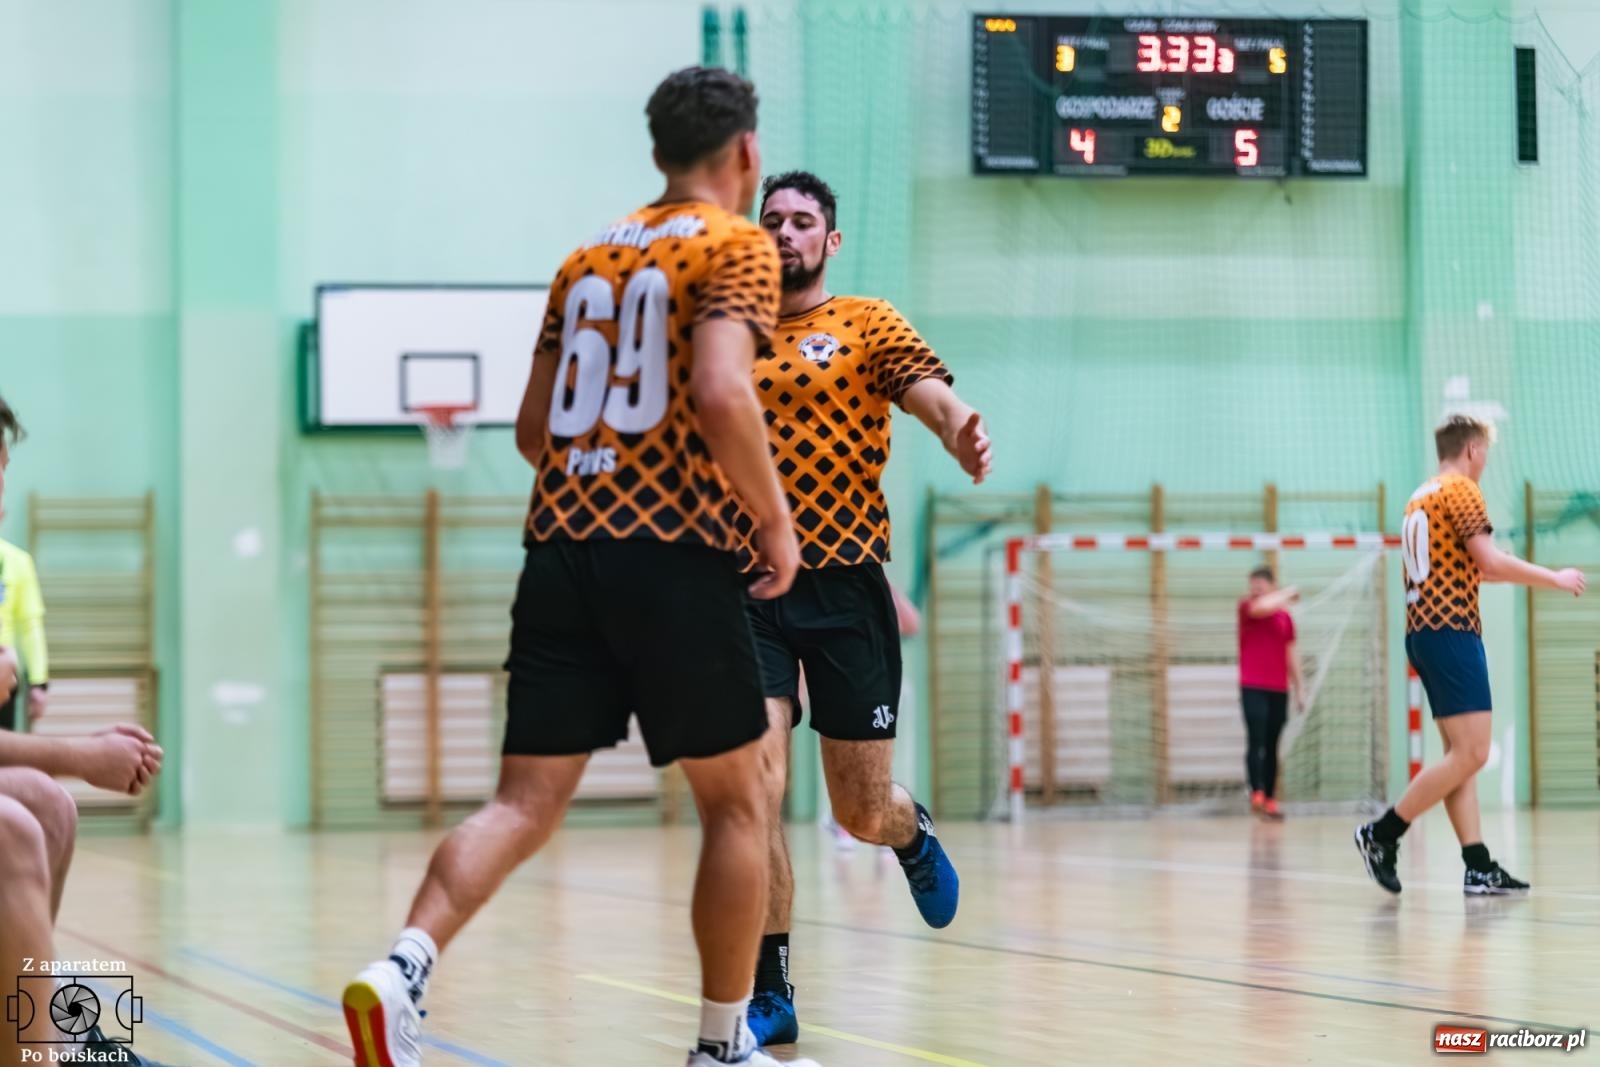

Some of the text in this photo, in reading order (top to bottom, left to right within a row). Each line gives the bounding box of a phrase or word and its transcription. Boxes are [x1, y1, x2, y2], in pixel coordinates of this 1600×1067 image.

[1161, 105, 1182, 133] 2
[1069, 127, 1096, 165] 4
[1233, 128, 1259, 166] 5
[548, 266, 669, 438] 69
